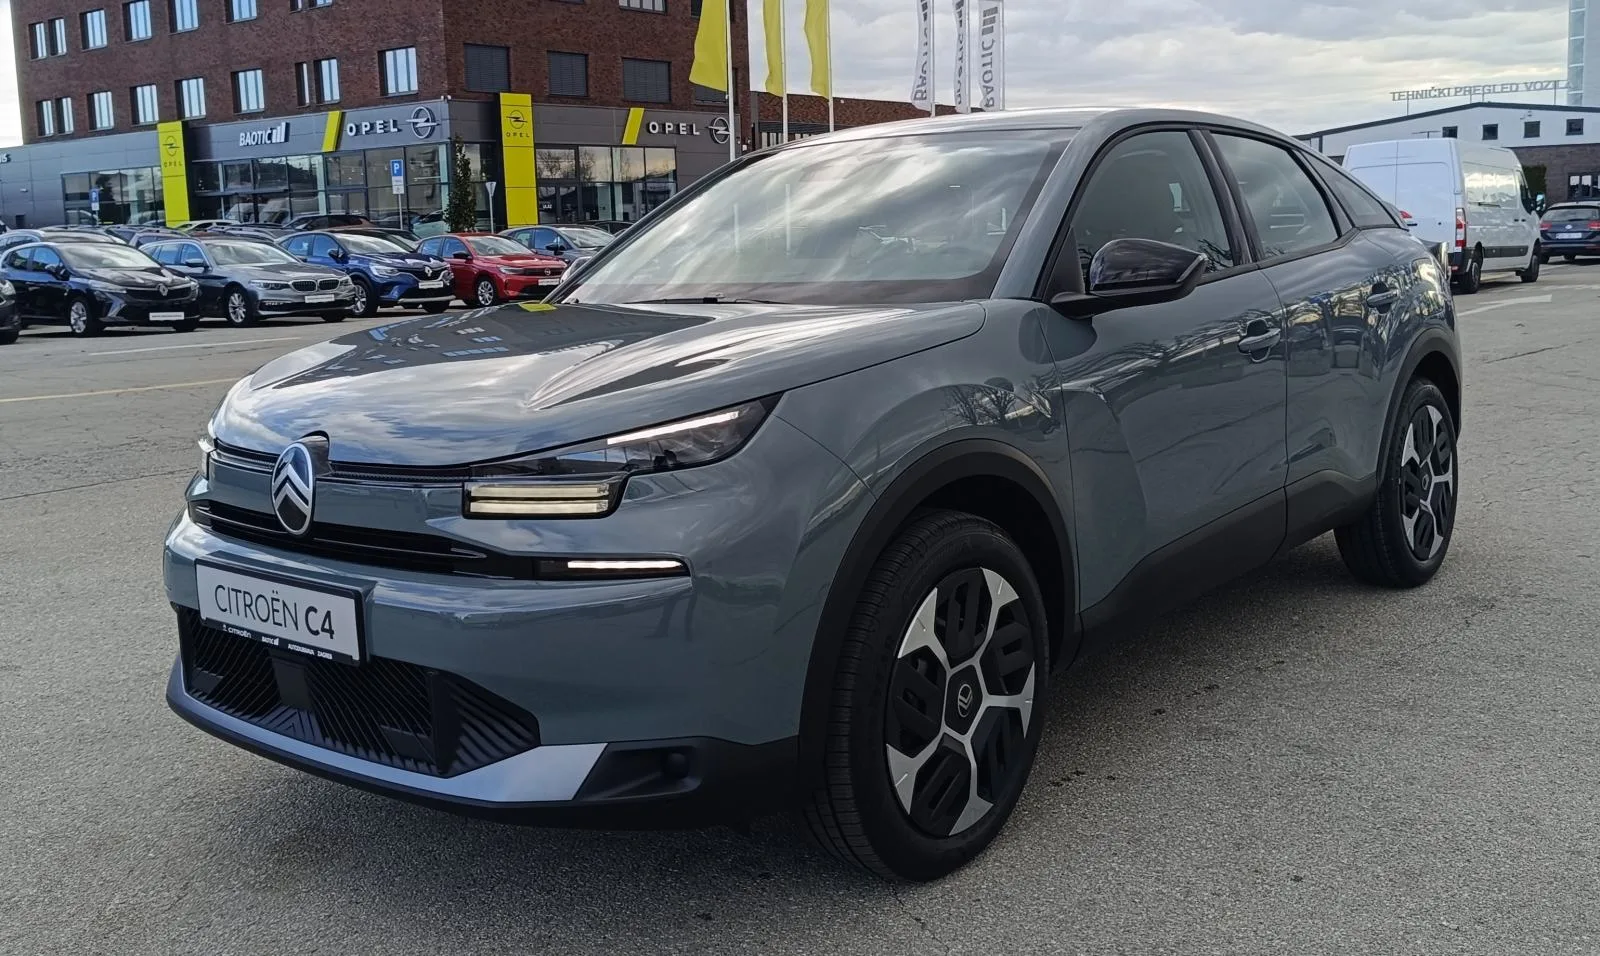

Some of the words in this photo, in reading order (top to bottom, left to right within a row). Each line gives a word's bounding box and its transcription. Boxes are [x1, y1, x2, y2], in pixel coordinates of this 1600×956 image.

[1390, 86, 1451, 102] TEHNIČKI
[1454, 82, 1519, 96] PREGLED
[1524, 79, 1574, 92] VOZILA
[346, 118, 400, 137] OPEL
[648, 120, 701, 136] OPEL
[393, 162, 400, 175] P
[214, 584, 300, 632] CITROËN
[304, 605, 335, 640] C4
